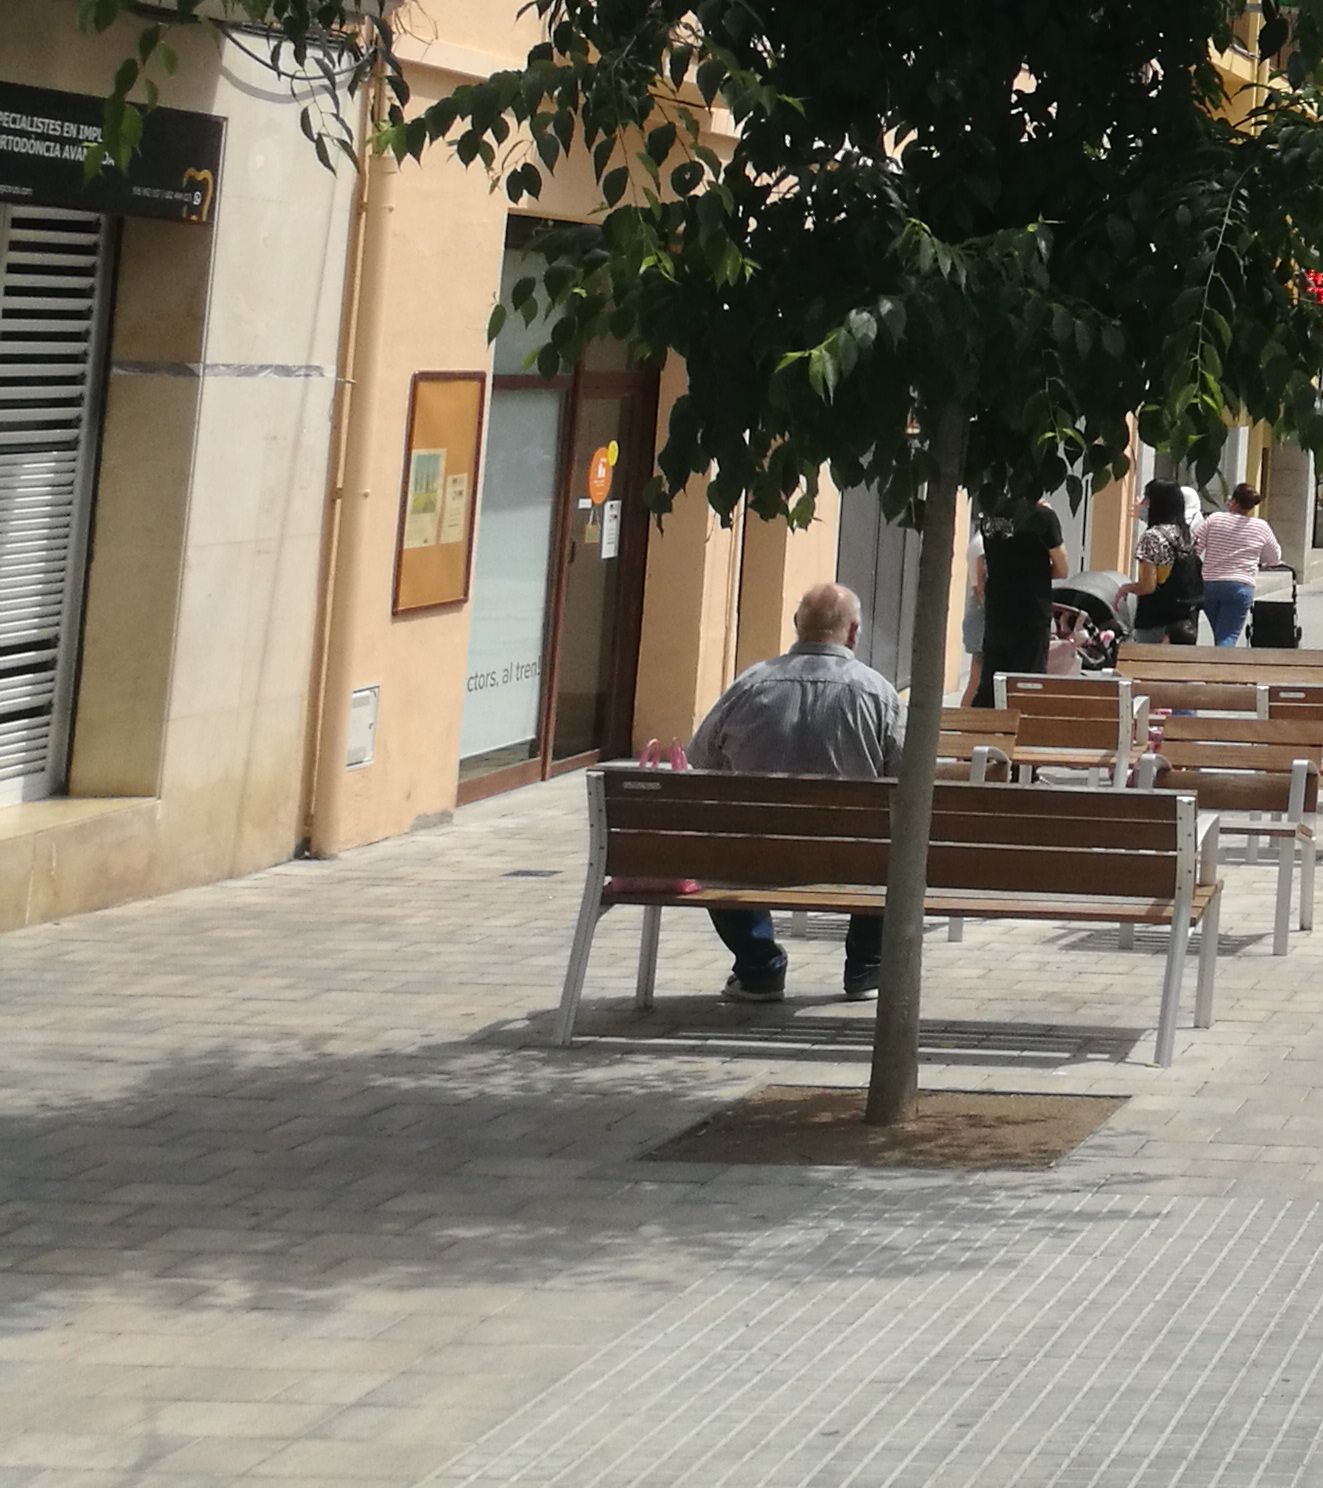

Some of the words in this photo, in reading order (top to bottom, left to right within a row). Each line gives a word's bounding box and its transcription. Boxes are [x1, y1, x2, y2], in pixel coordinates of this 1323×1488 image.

[63, 122, 78, 138] EN
[502, 662, 513, 684] al
[516, 655, 541, 681] tren!
